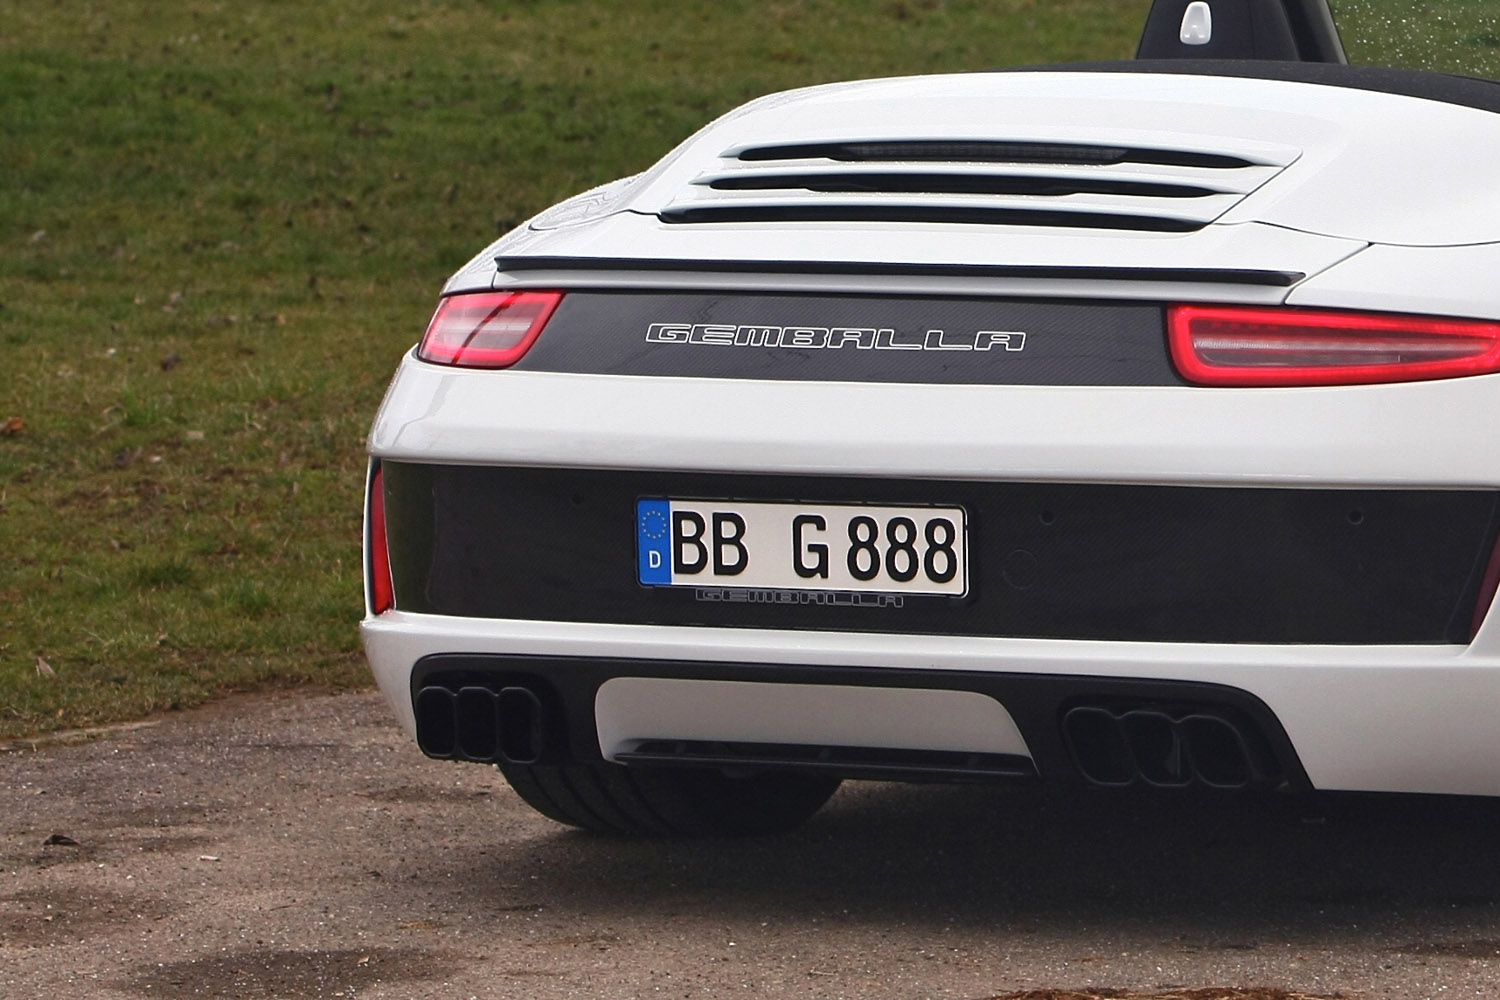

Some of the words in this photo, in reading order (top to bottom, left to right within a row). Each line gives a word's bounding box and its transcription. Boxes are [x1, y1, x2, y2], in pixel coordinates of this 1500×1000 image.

[646, 323, 1026, 351] GEMBALLA
[673, 511, 748, 575] BB
[792, 515, 829, 579] G
[847, 516, 957, 583] 888
[649, 551, 661, 568] D
[695, 588, 904, 608] GEMBALLA
